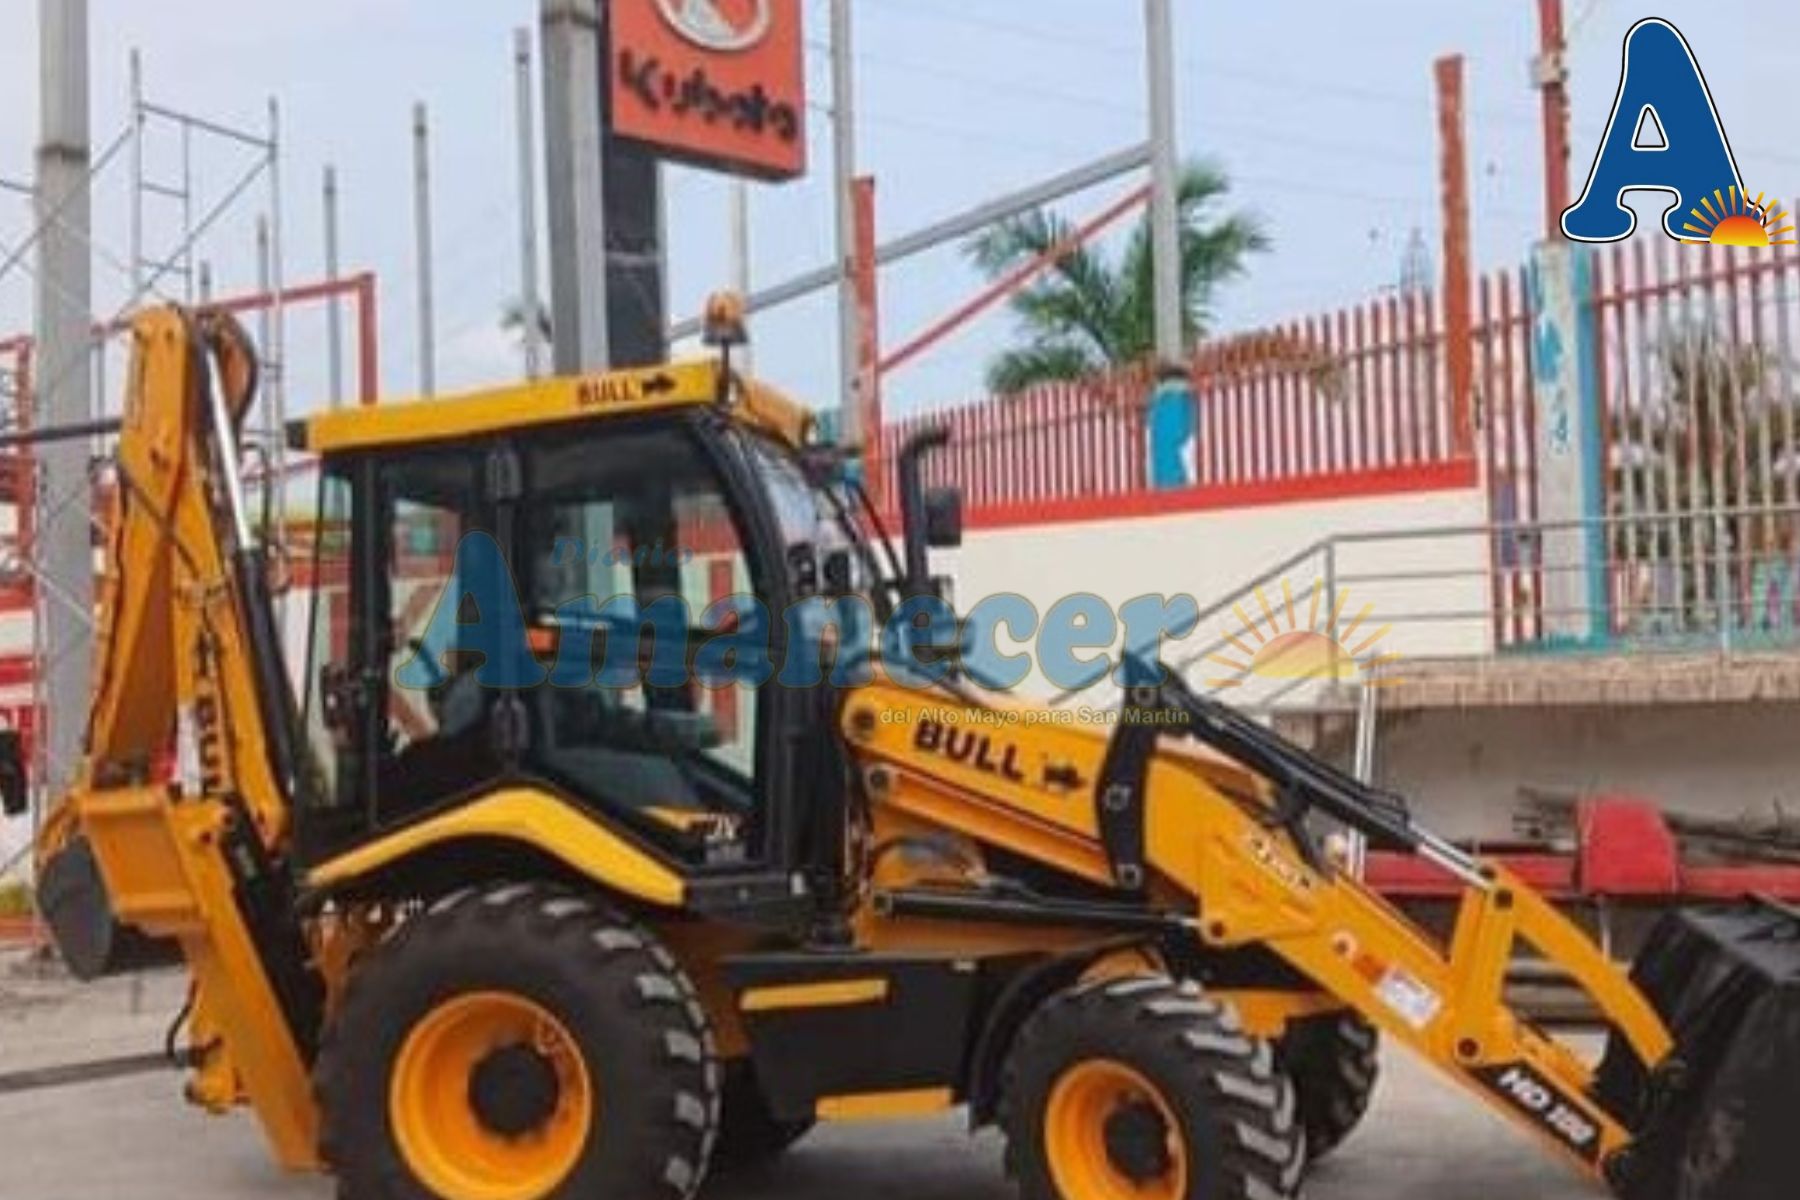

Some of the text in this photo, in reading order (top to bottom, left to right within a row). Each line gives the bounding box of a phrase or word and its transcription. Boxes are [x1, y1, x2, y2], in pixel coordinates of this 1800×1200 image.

[619, 50, 798, 141] Kubota
[578, 376, 638, 405] BULL
[914, 719, 1024, 782] BULL
